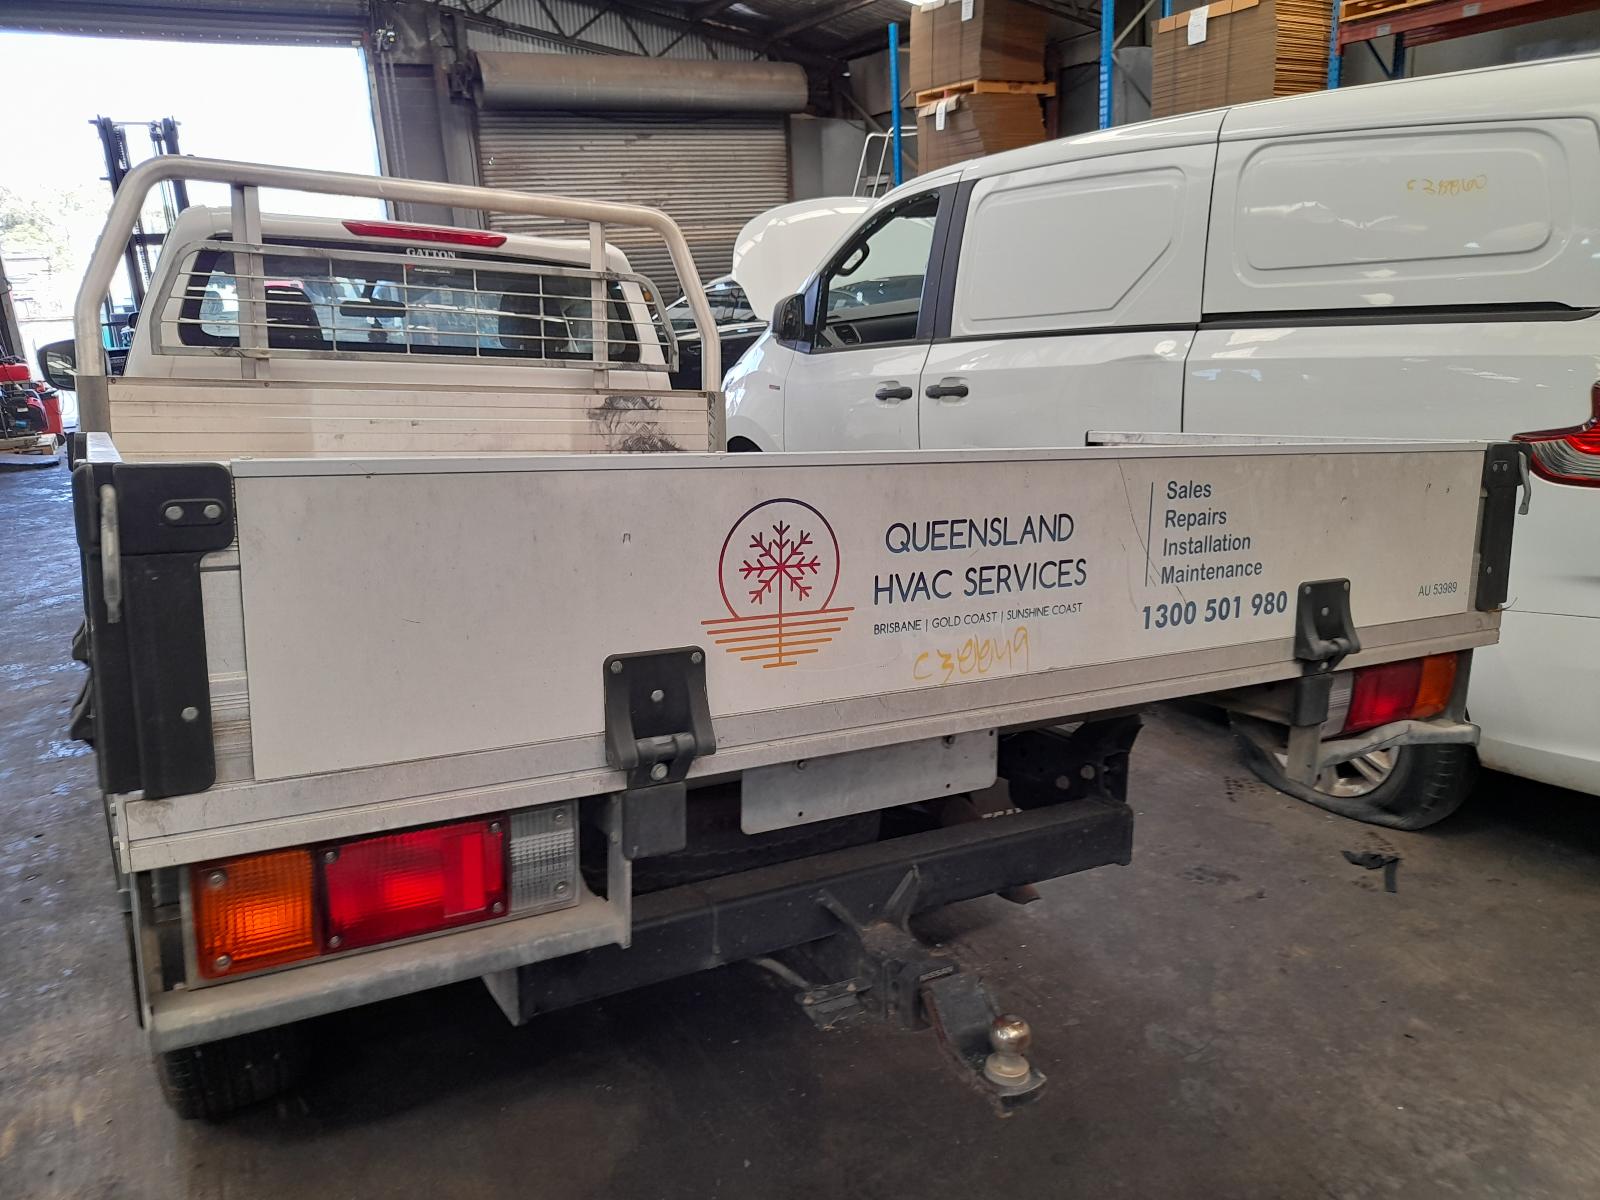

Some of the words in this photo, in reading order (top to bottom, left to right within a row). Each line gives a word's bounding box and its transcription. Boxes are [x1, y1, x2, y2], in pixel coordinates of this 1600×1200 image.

[405, 247, 456, 260] GATTON
[1166, 480, 1212, 500] Sales
[1164, 507, 1227, 531] Repairs
[885, 513, 1075, 553] QUEENSLAND
[1162, 533, 1251, 557] Installation
[873, 569, 953, 605] HVAC
[963, 558, 1087, 597] SERVICES
[1160, 560, 1263, 585] Maintenance
[1418, 585, 1431, 597] AU
[1433, 581, 1458, 595] 53989
[873, 619, 922, 635] BRISBANE
[931, 615, 961, 629] GOLD
[963, 611, 998, 625] COAST
[1006, 605, 1050, 621] SUNSHINE
[1051, 602, 1083, 616] COAST
[1142, 601, 1197, 630] 1300
[1204, 595, 1241, 623] 501
[1251, 590, 1288, 617] 980
